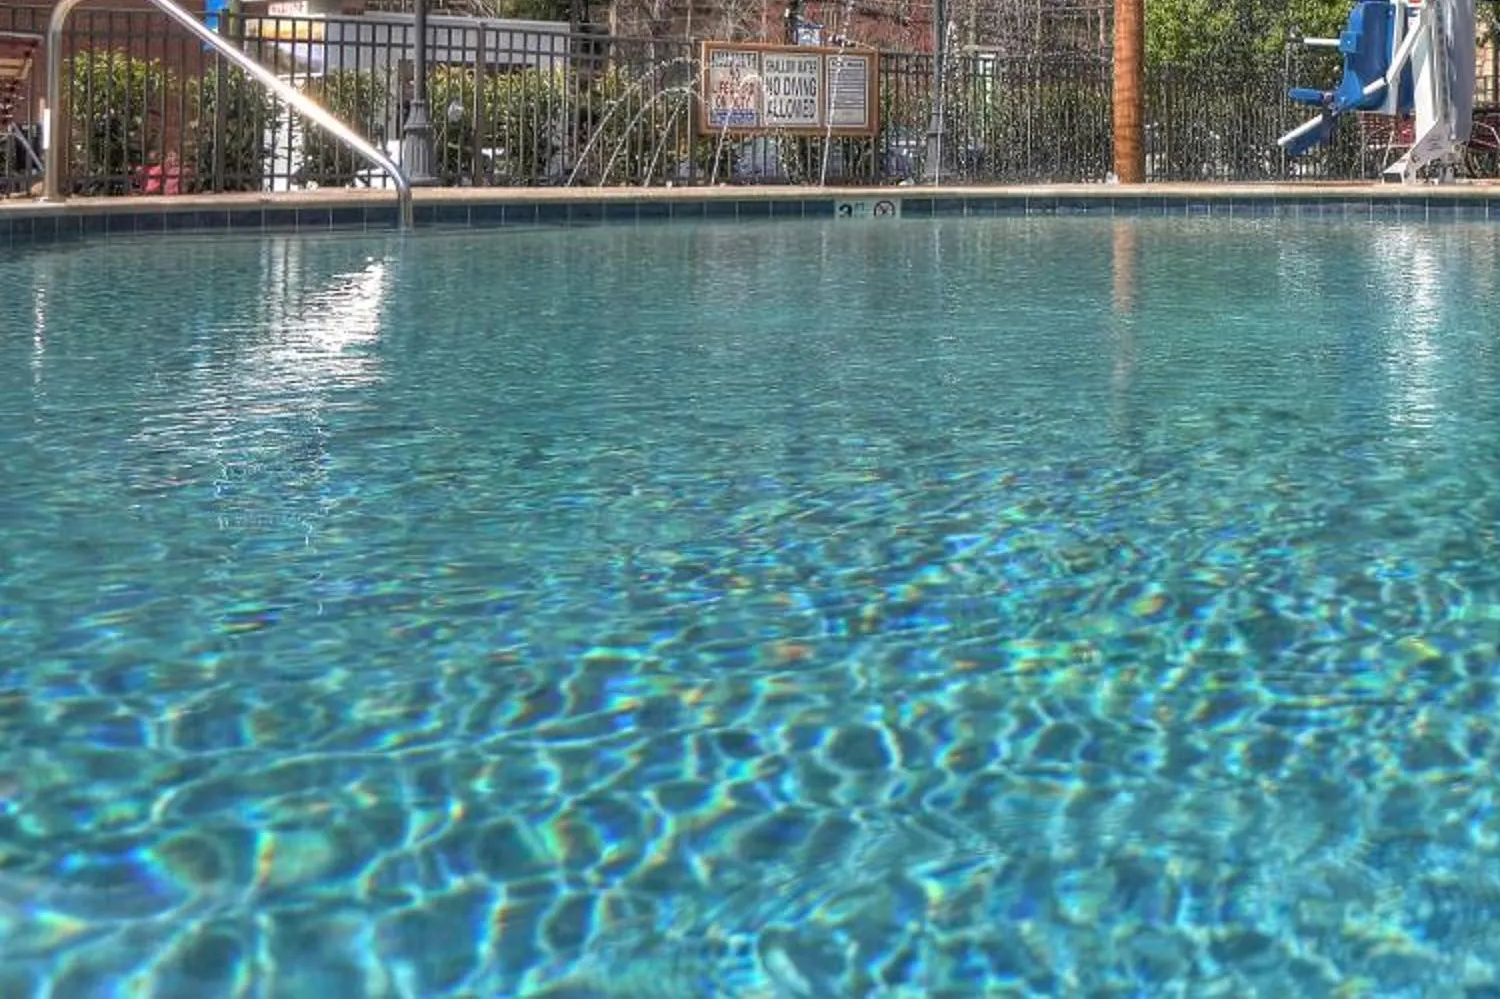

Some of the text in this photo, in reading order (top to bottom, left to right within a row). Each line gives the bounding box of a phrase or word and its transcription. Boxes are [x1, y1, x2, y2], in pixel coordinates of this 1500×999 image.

[766, 77, 781, 96] NO
[783, 77, 817, 97] DIVING
[766, 98, 816, 119] ALLOWED
